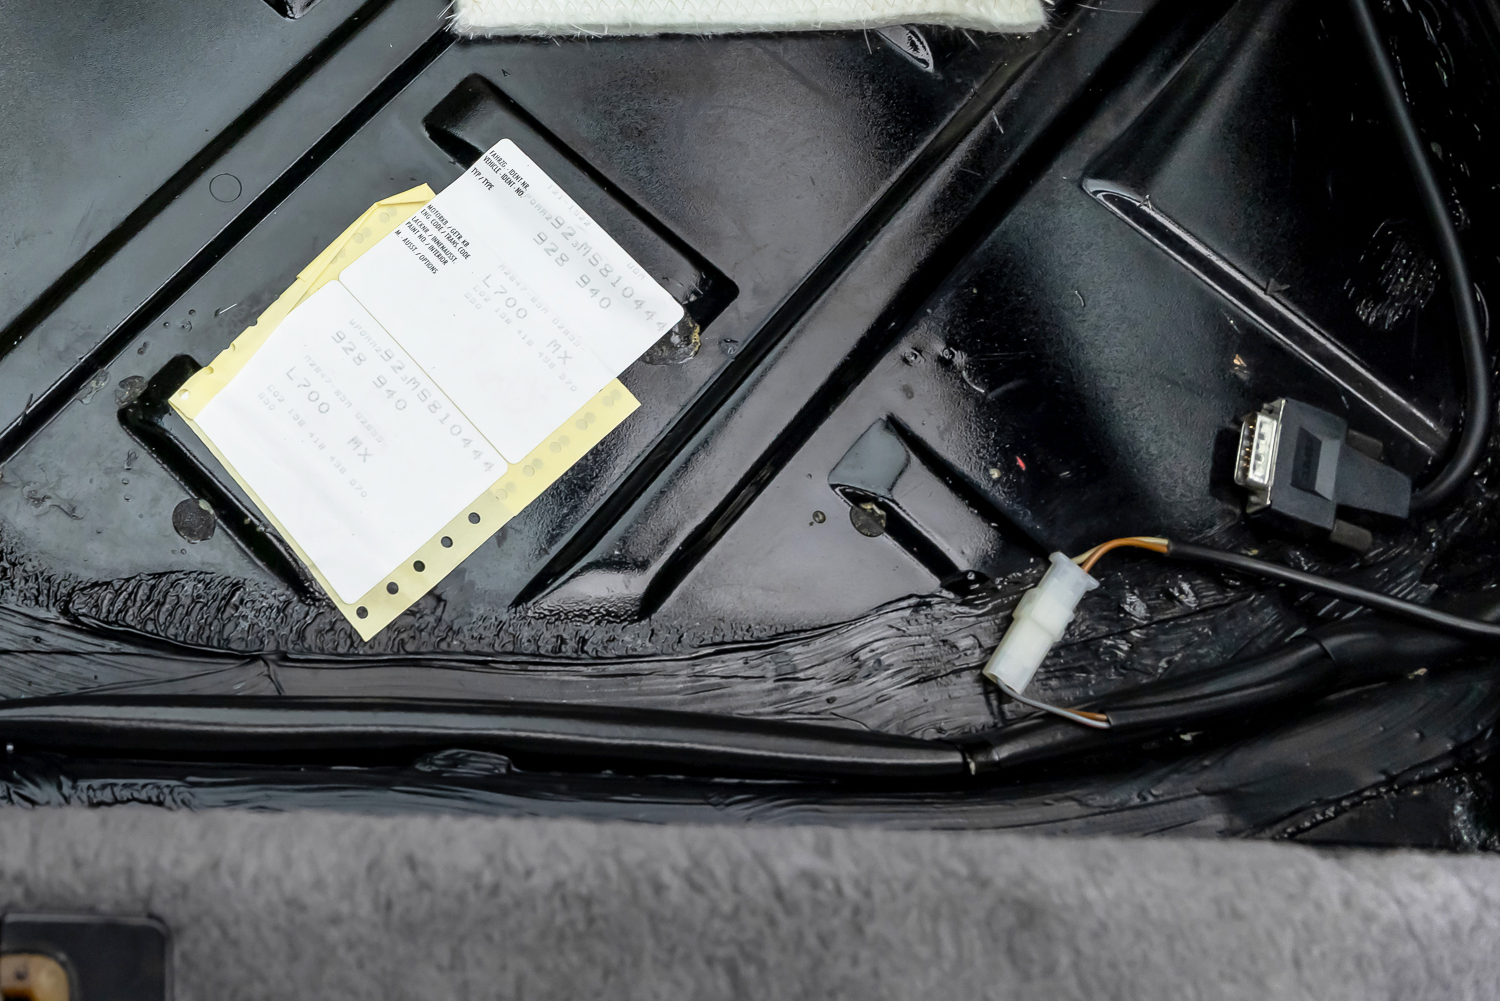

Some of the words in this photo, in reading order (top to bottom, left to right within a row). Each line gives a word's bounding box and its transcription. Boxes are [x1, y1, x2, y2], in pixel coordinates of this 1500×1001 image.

[483, 156, 500, 172] VEHICLE
[406, 222, 418, 233] PAINT
[419, 255, 437, 273] OPTIONS
[458, 247, 469, 258] CODE
[533, 232, 569, 266] 928
[576, 274, 612, 309] 940
[482, 274, 528, 320] L700
[547, 339, 572, 364] MX
[332, 329, 366, 366] 928
[373, 374, 407, 411] 940
[286, 366, 330, 415] L700
[347, 436, 372, 462] MX
